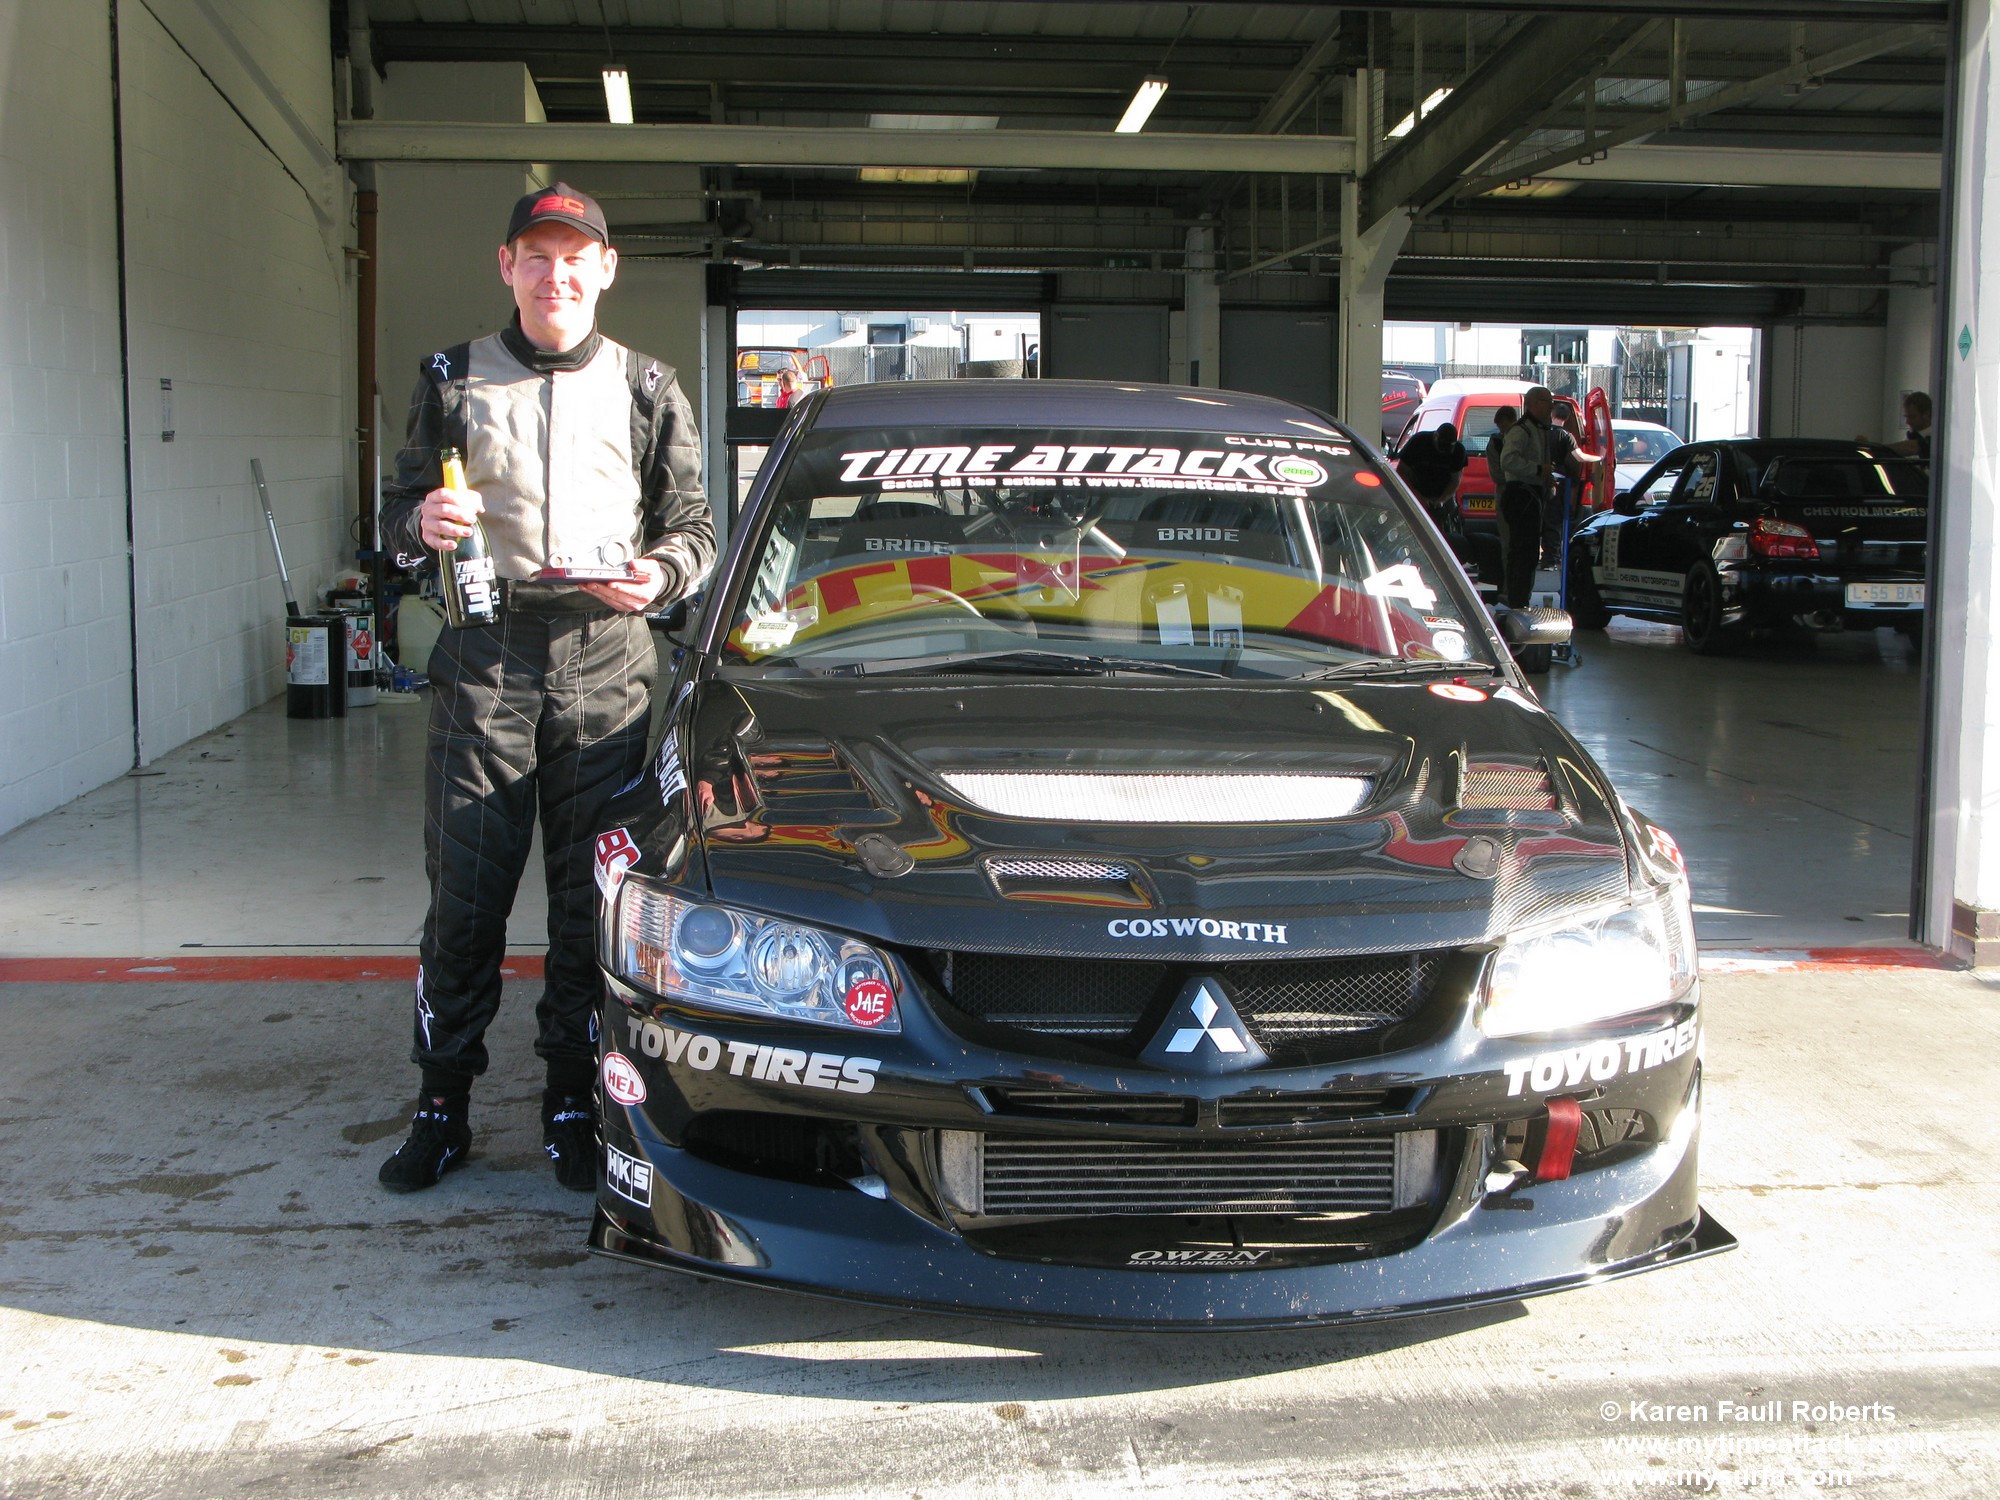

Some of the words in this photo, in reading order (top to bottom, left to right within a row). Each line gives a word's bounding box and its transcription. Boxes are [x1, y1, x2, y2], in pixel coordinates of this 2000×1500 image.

[1224, 436, 1291, 449] CLUB
[1295, 441, 1350, 456] PRO
[1283, 467, 1314, 476] 2009
[881, 479, 934, 490] Catch
[940, 478, 962, 488] all
[1693, 477, 1715, 498] 26
[1469, 500, 1493, 509] NY02
[1803, 507, 1869, 517] CHEVRON
[1872, 507, 1928, 517] MOTORS
[1157, 527, 1240, 543] BRIDE
[864, 537, 951, 555] BRIDE
[1363, 563, 1438, 611] 4
[1853, 587, 1862, 600] L
[1869, 586, 1888, 600] 55
[464, 582, 493, 614] 3
[291, 629, 310, 643] GT
[1107, 917, 1289, 945] COSWORTH
[850, 991, 887, 1013] JAE
[627, 1016, 721, 1071] TOYO
[727, 1041, 882, 1094] TIRES
[1503, 1040, 1621, 1097] TOYO
[1623, 1012, 1698, 1074] TIRES
[608, 1072, 639, 1098] HEL
[607, 1151, 649, 1190] HKS
[1130, 1250, 1270, 1261] OWEN
